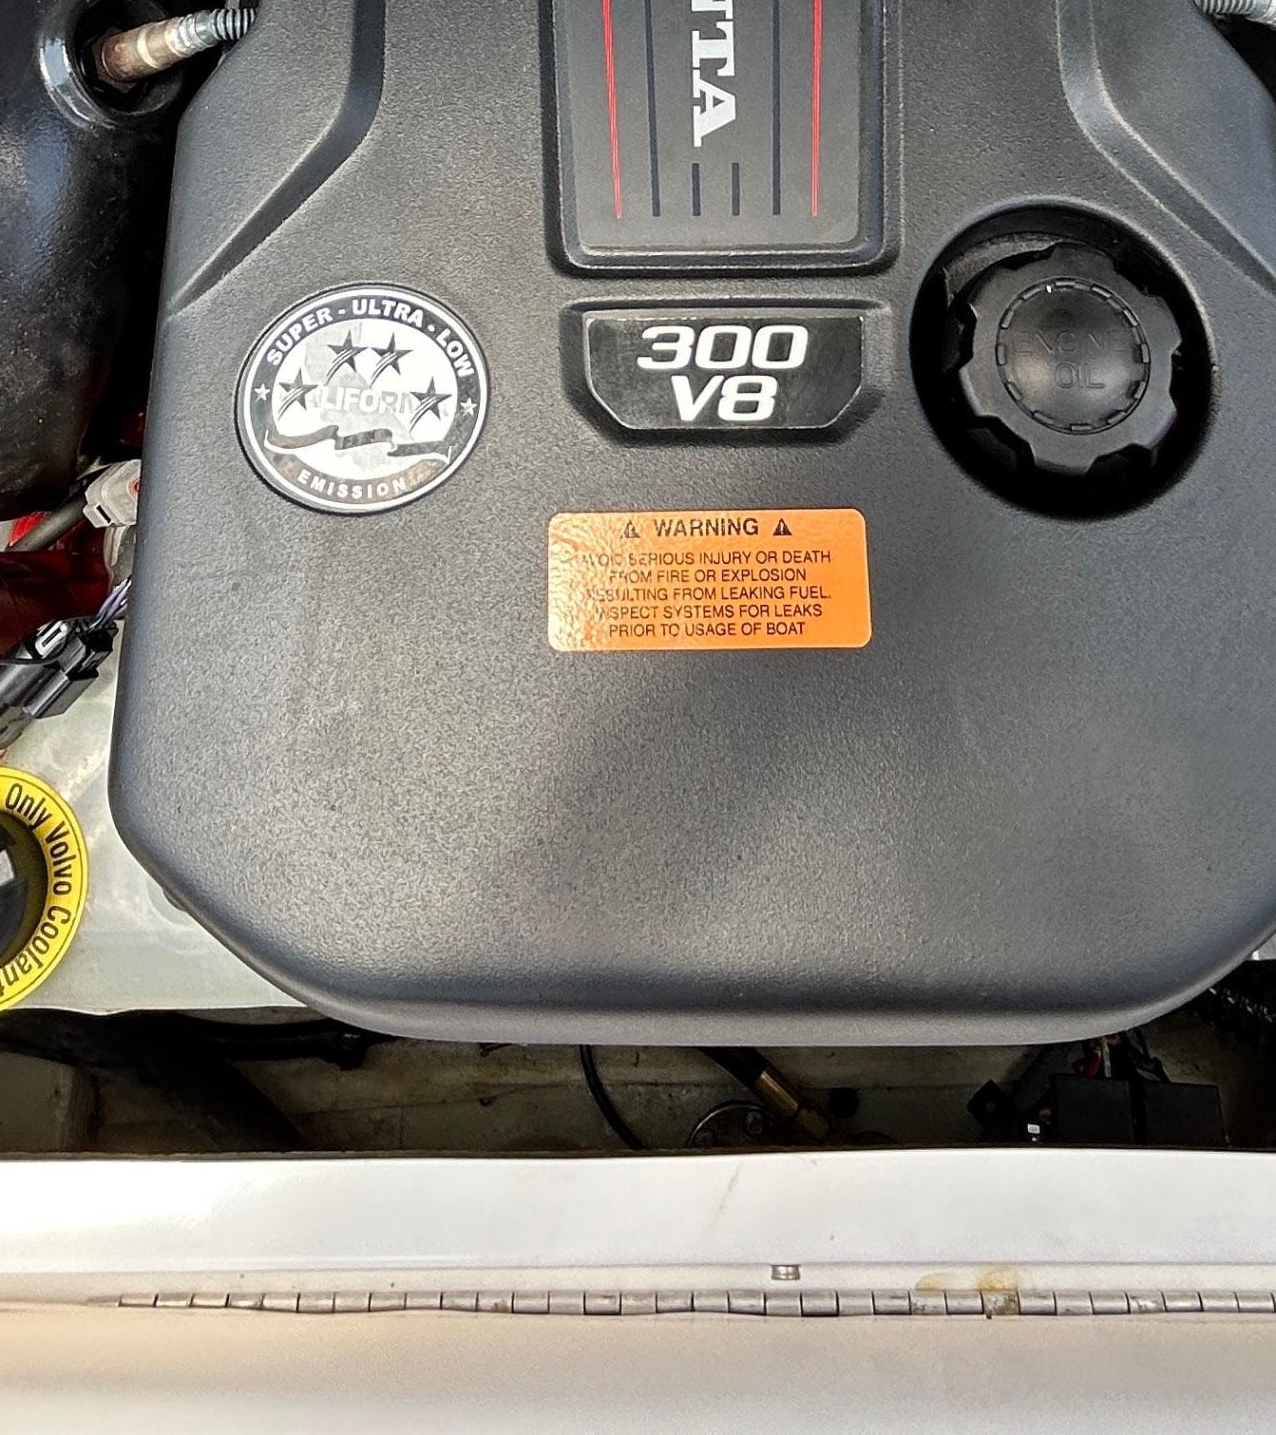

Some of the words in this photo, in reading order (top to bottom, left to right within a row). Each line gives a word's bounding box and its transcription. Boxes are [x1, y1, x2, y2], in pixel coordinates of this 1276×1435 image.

[266, 308, 334, 366] SUPER
[352, 298, 425, 329] ULTRA
[436, 328, 475, 378] LOW
[636, 325, 809, 370] 300
[1055, 362, 1106, 389] OIL
[670, 375, 779, 422] V8
[297, 468, 408, 499] EMISSION
[654, 517, 759, 538] WARNING
[628, 552, 695, 566] SERIOUS
[699, 550, 752, 565] INJURY
[755, 550, 778, 565] OR
[782, 549, 832, 564] DEATH
[609, 569, 653, 584] FROM
[656, 569, 690, 583] FIRE
[694, 568, 717, 583] OR
[721, 568, 807, 583] EXPLOSION
[673, 587, 717, 601] FROM
[721, 586, 785, 600] LEAKING
[789, 585, 832, 599] FUEL.
[662, 604, 735, 619] SYSTEMS
[739, 604, 770, 618] FOR
[774, 603, 823, 617] LEAKS
[609, 623, 655, 638] PRIOR
[660, 623, 680, 637] TO
[684, 622, 737, 637] USAGE
[741, 621, 762, 636] OF
[766, 621, 806, 636] BOAT
[5, 783, 53, 832] Only
[45, 820, 77, 896] Volvo
